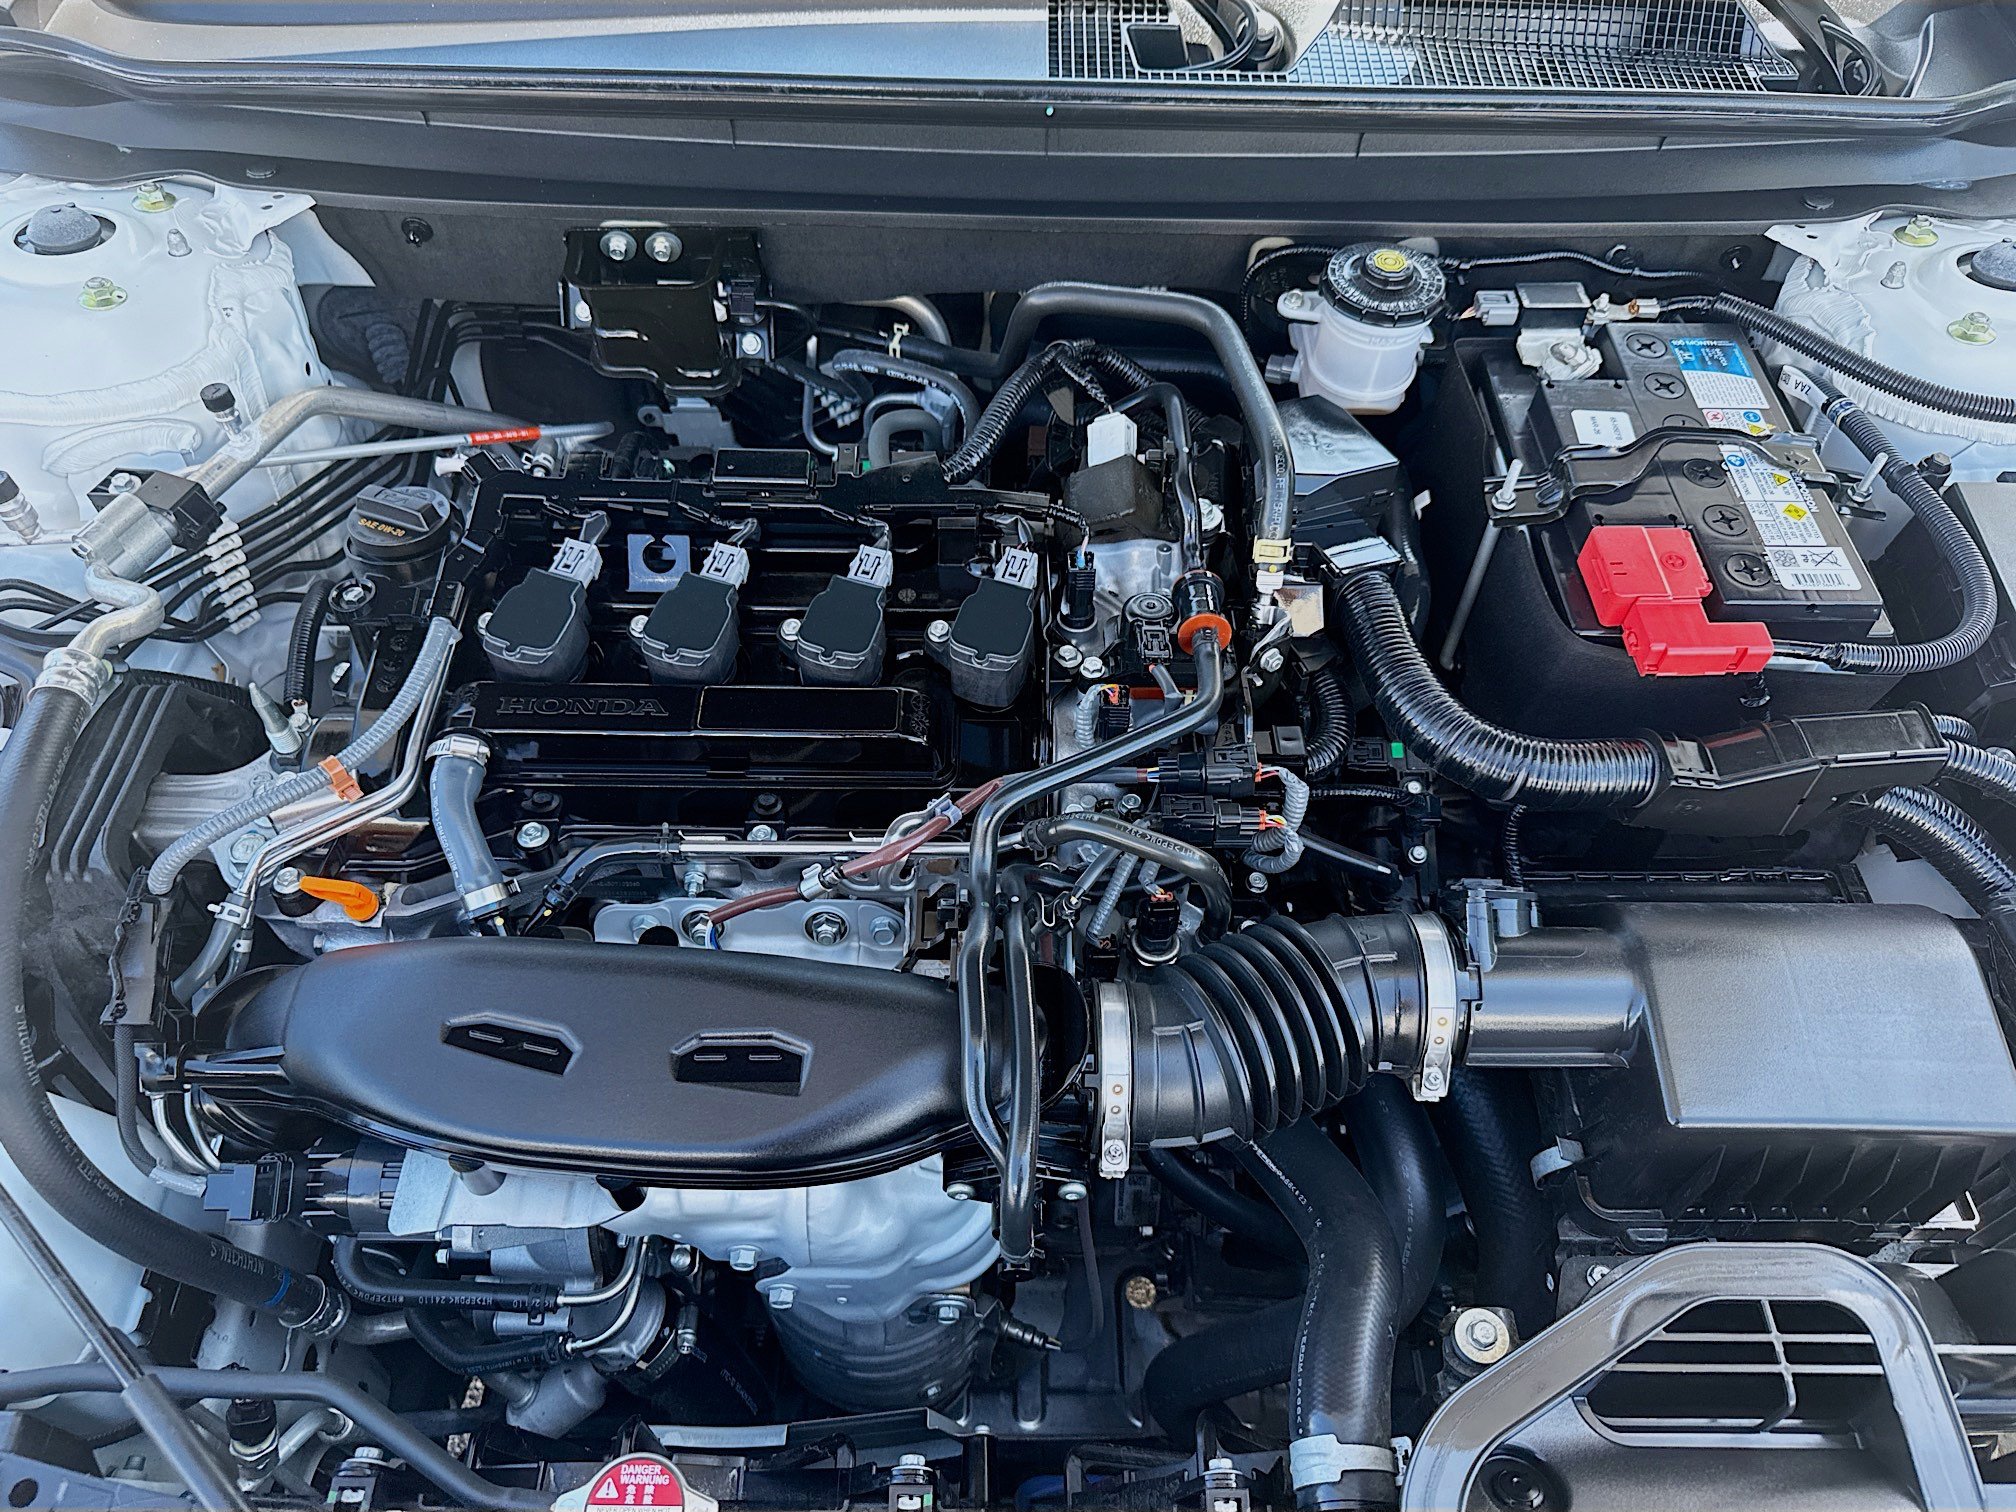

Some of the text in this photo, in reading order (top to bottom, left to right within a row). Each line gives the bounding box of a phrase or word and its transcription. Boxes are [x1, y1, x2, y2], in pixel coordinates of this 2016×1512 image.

[1795, 380, 1811, 395] ZAA
[358, 518, 405, 537] SAE 0W-20
[496, 697, 669, 716] HONDA
[621, 1464, 661, 1475] DANGER
[620, 1475, 670, 1485] WARNUNG
